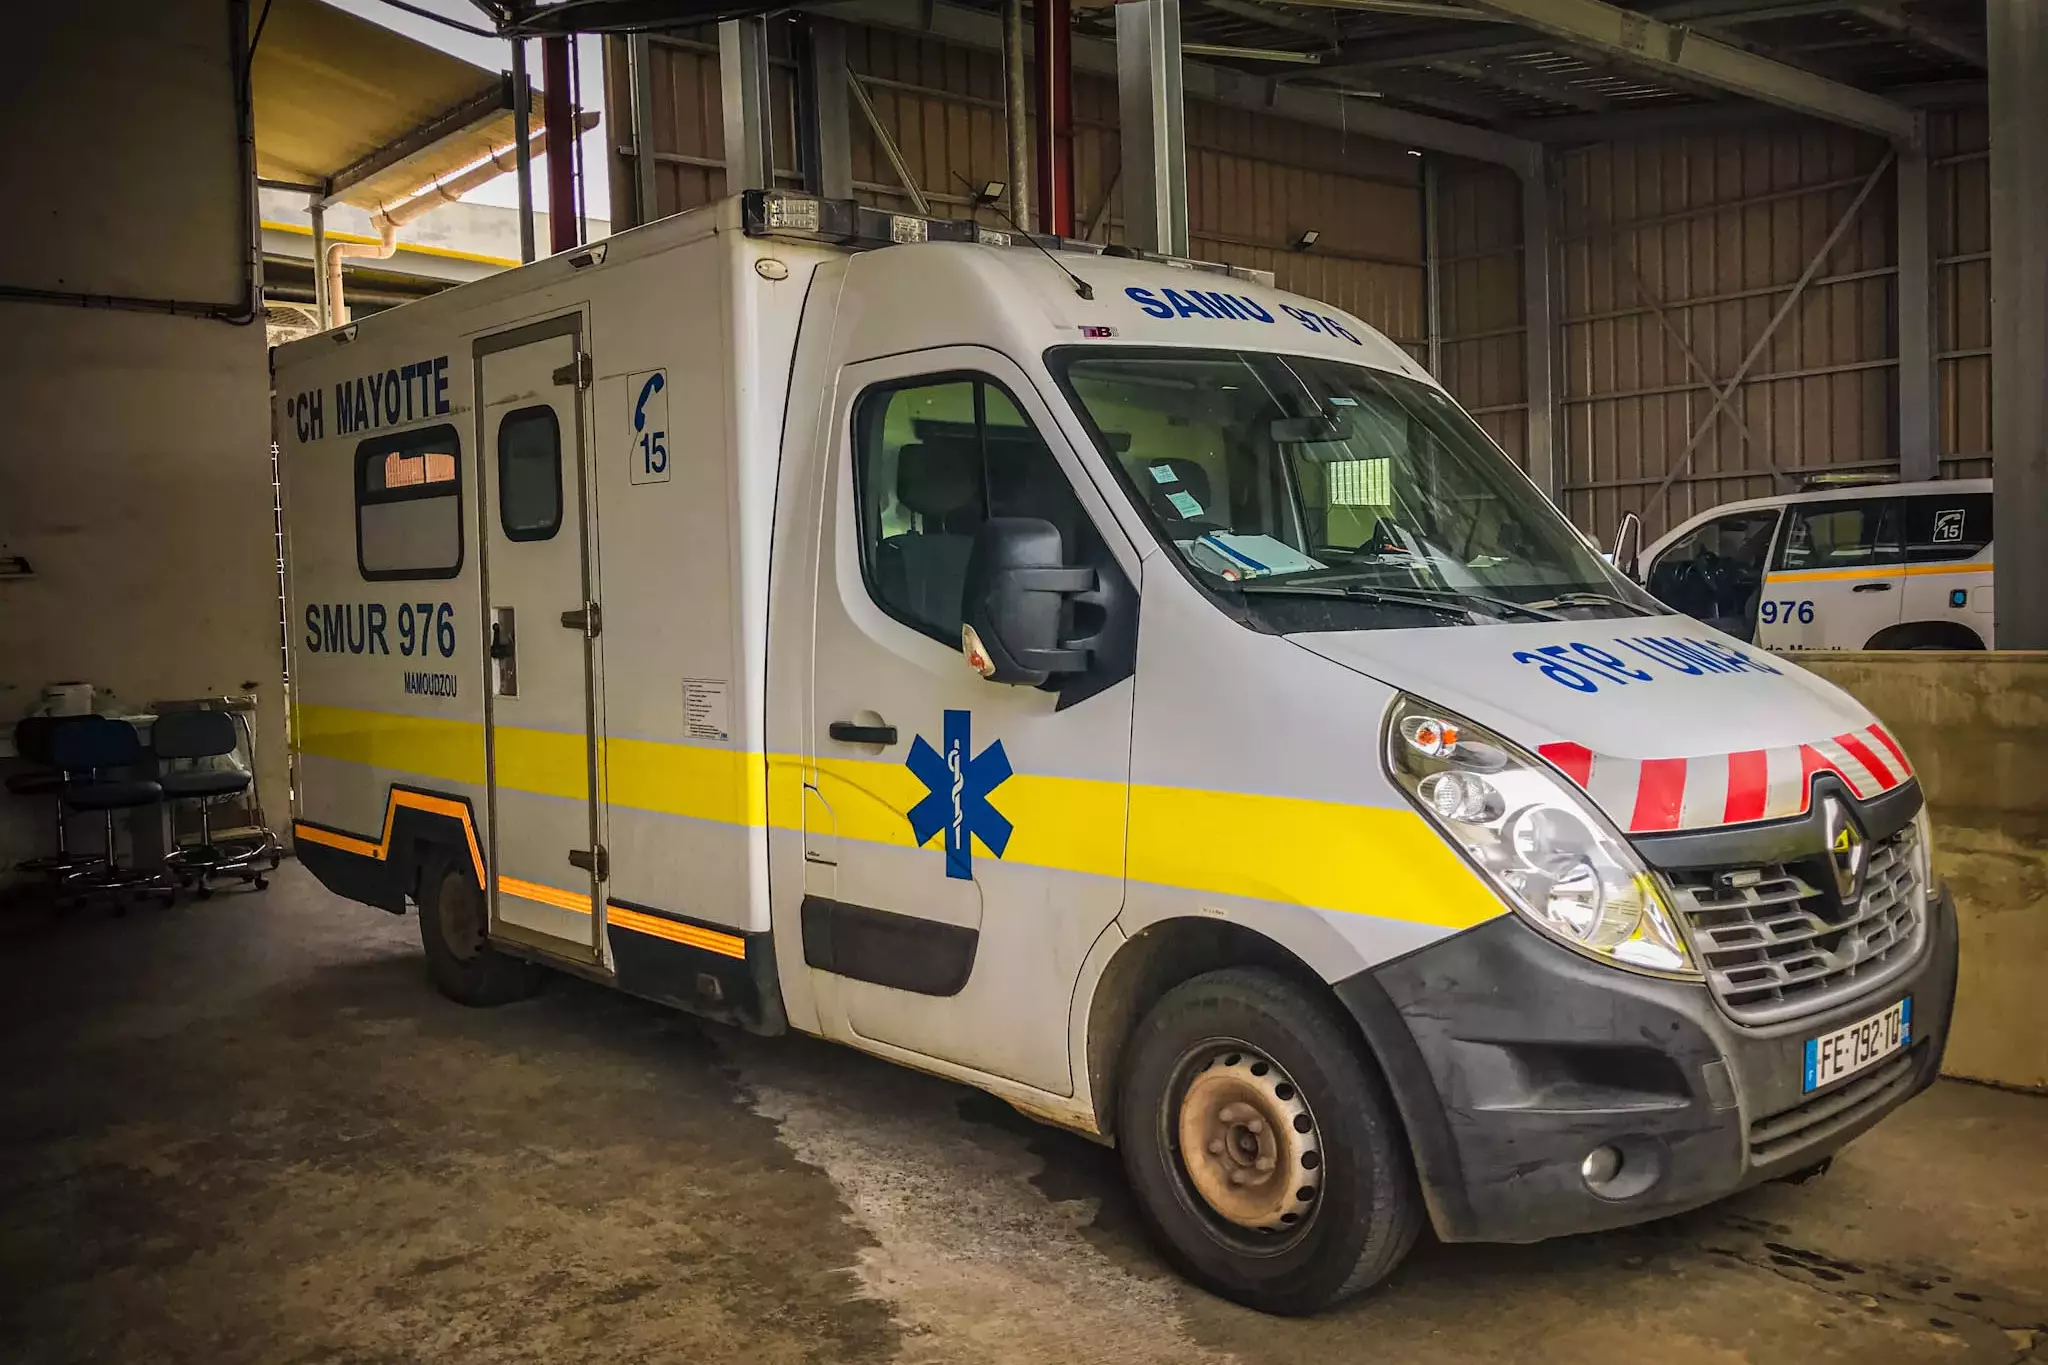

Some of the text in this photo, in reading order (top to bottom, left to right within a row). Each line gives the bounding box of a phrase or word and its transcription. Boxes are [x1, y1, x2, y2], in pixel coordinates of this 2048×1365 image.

[1124, 287, 1363, 346] SAMU 976
[335, 355, 450, 436] MAYOTTE
[640, 431, 667, 474] 15
[1941, 524, 1960, 539] 15
[305, 602, 456, 658] SMUR 976
[1761, 600, 1815, 624] 976
[403, 672, 457, 698] MAMOUDZOU
